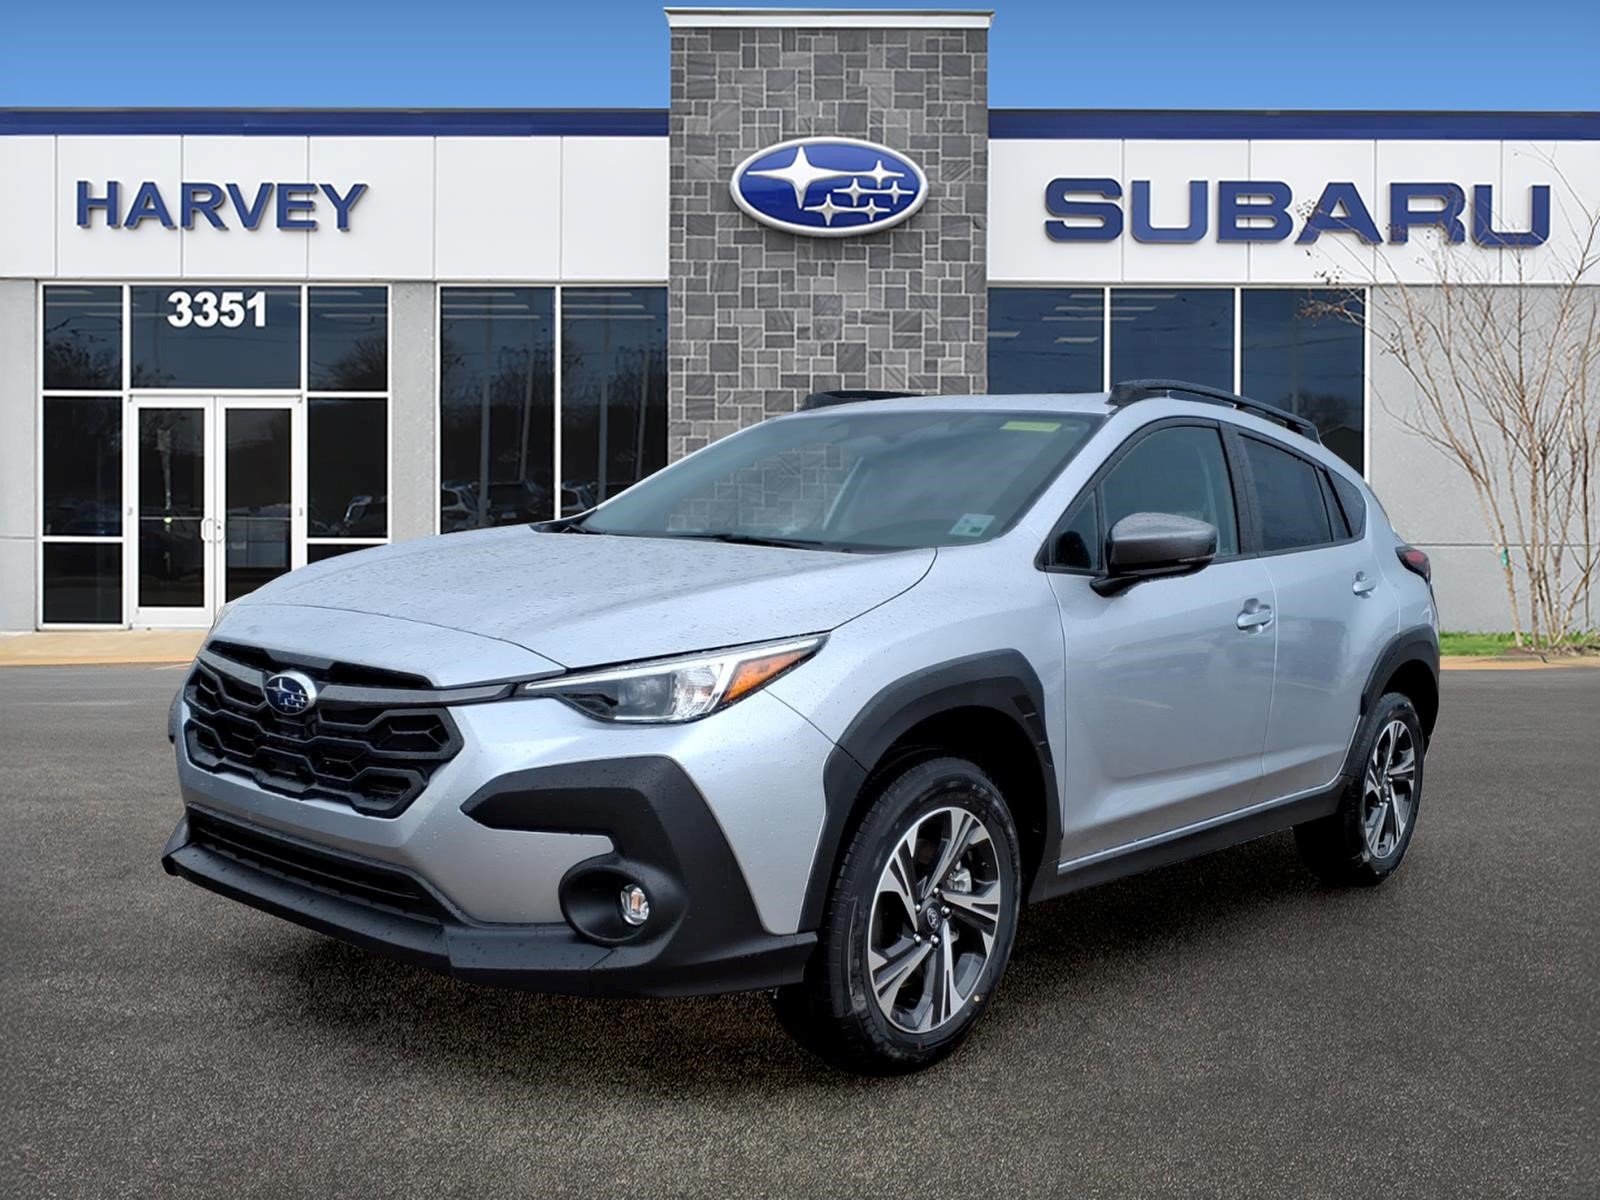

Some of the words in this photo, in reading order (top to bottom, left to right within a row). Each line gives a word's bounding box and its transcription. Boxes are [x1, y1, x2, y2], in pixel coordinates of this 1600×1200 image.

[76, 181, 368, 232] HARVEY
[1044, 177, 1551, 247] SUBARU
[167, 291, 267, 328] 3351
